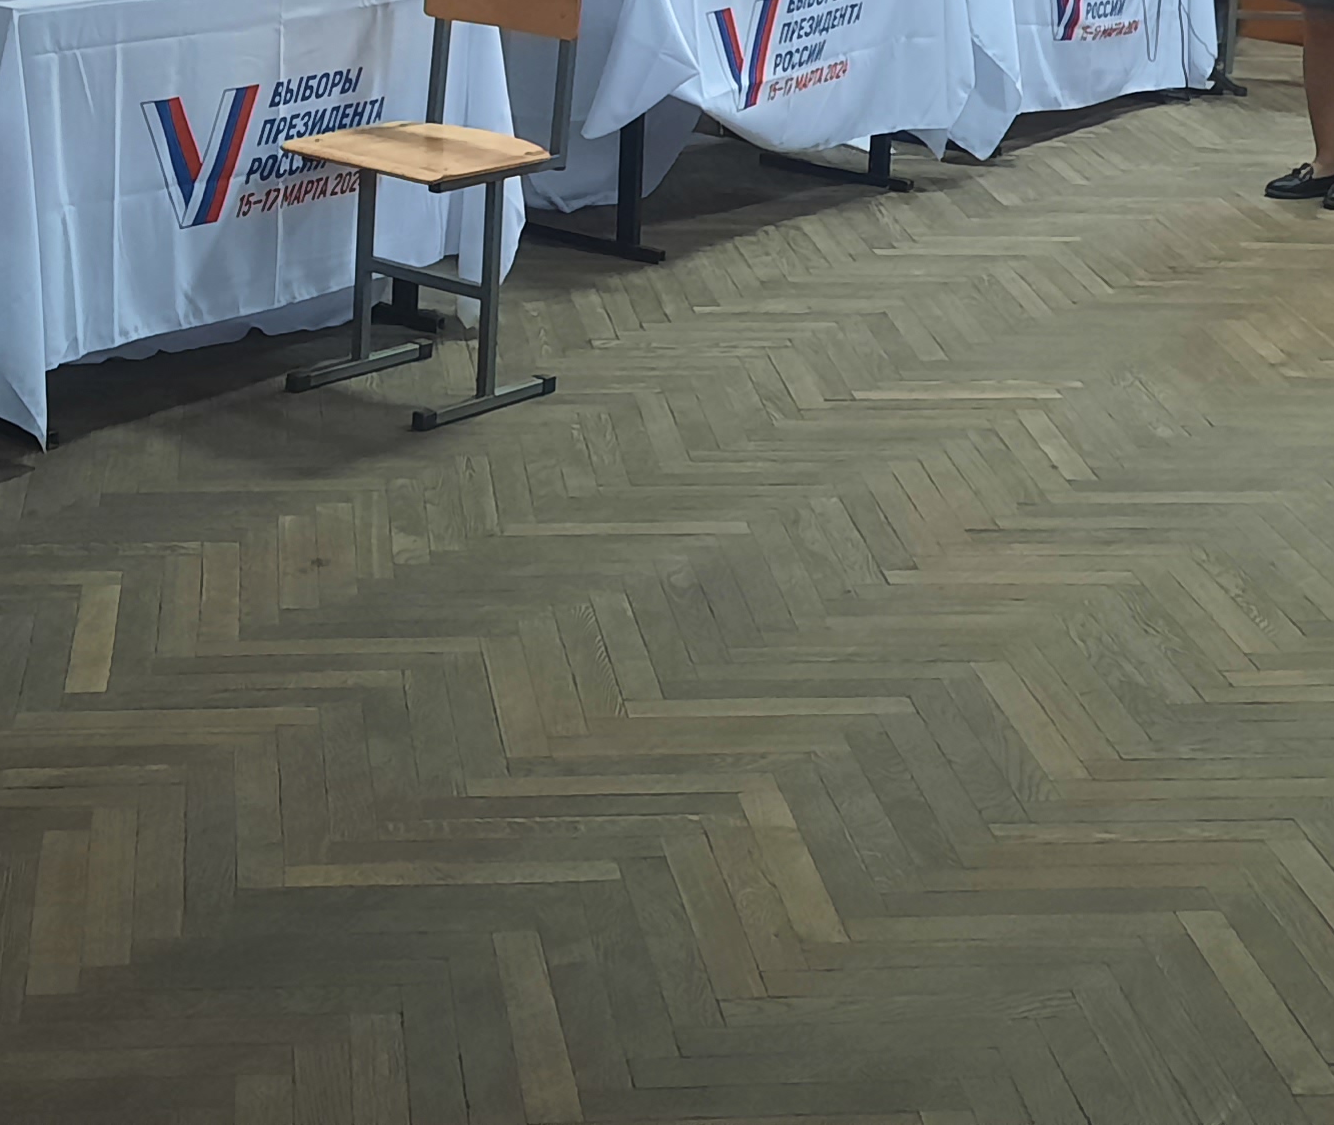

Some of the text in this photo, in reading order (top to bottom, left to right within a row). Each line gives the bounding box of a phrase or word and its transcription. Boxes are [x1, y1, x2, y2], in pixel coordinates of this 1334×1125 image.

[779, 1, 863, 45] ПРЕЗИДЕНТА
[773, 39, 827, 76] РОССИИ
[268, 66, 364, 109] ВЫБОРЫ
[256, 96, 385, 147] ПРЕЗИДЕНТА
[280, 176, 330, 210] МАРТА
[330, 170, 362, 198] 202
